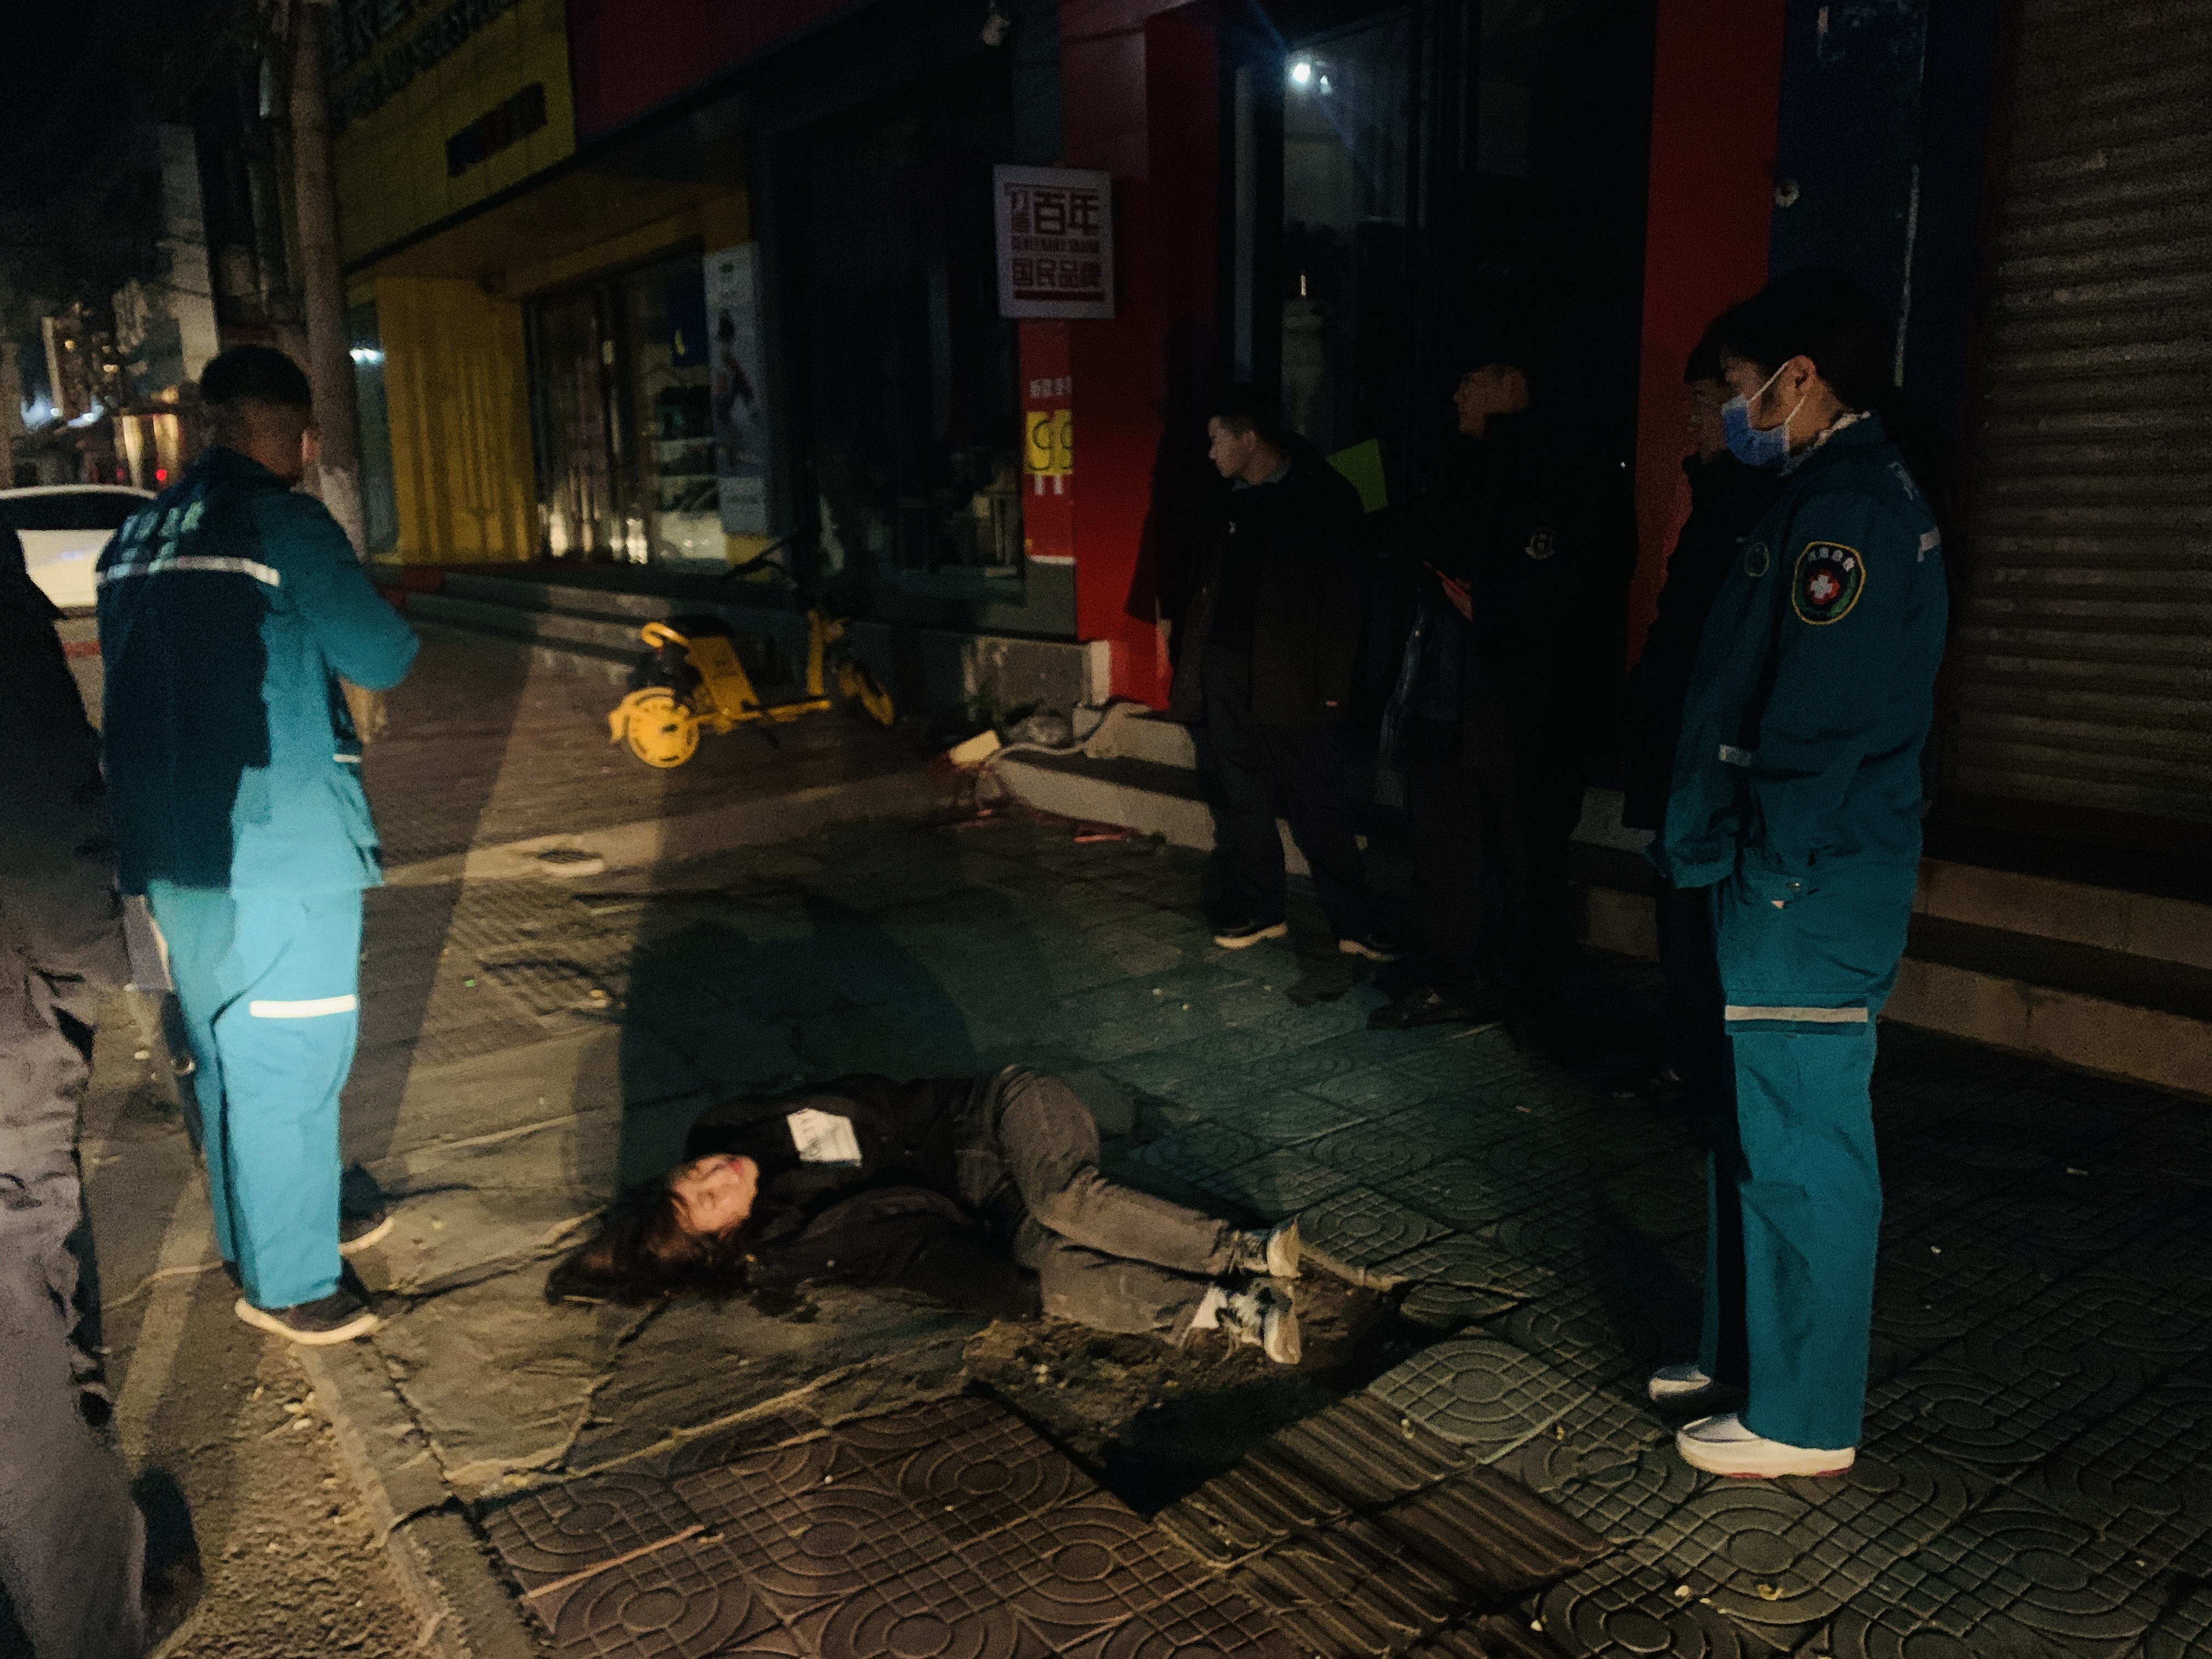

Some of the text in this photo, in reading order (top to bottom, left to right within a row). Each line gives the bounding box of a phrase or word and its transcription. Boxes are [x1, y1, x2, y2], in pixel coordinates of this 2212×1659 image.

[1034, 191, 1099, 236] 百年
[1012, 257, 1102, 287] 国民品牌
